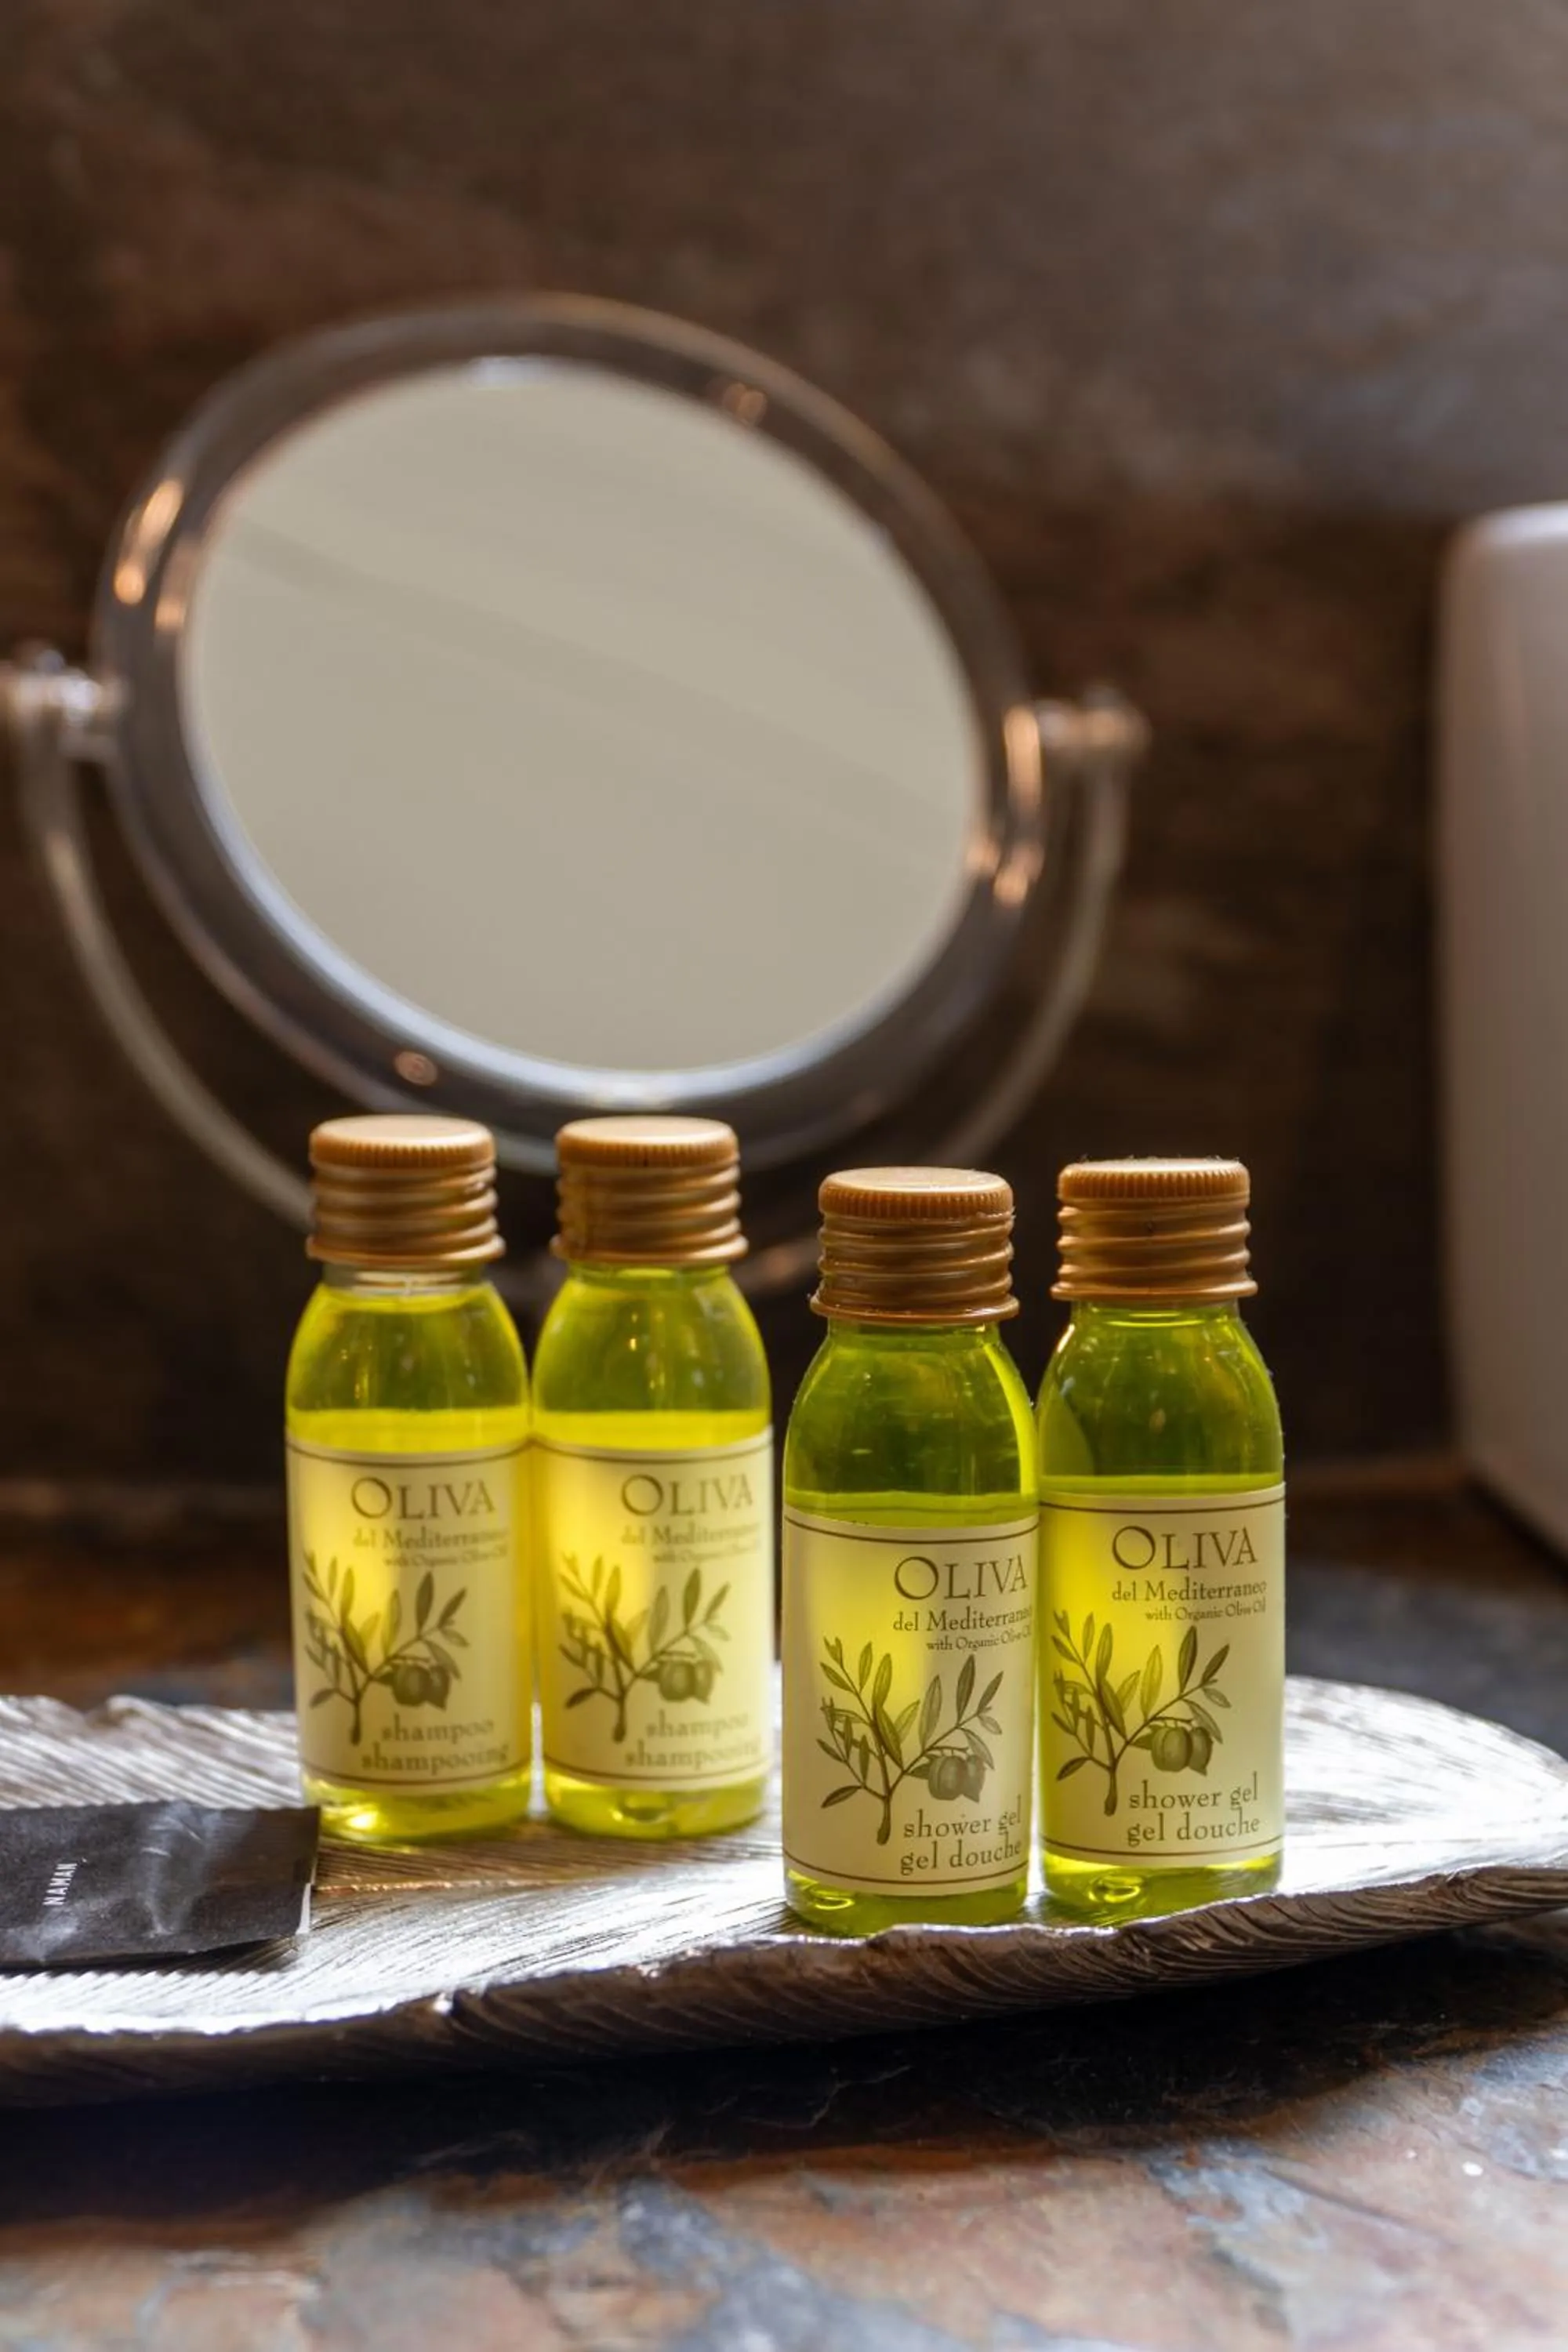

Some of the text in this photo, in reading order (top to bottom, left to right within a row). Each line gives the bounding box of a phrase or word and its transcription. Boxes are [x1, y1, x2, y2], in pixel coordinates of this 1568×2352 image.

[350, 1476, 496, 1520] OLIVA
[620, 1473, 754, 1517] OLIVA
[1112, 1525, 1258, 1571] OLIVA
[894, 1555, 1029, 1600] OLIVA
[1111, 1575, 1267, 1602] del Mediterraneo
[892, 1610, 920, 1632] del
[1145, 1605, 1173, 1621] with
[1175, 1606, 1222, 1622] Organic
[926, 1635, 953, 1651] with
[955, 1635, 1000, 1652] Organic
[382, 1711, 495, 1745] shampoo
[1128, 1770, 1258, 1810] shower gel
[903, 1794, 1022, 1838] shower gel
[1127, 1806, 1261, 1847] gel douche
[899, 1831, 1022, 1877] gel douche
[42, 1862, 78, 1906] NAMAN
